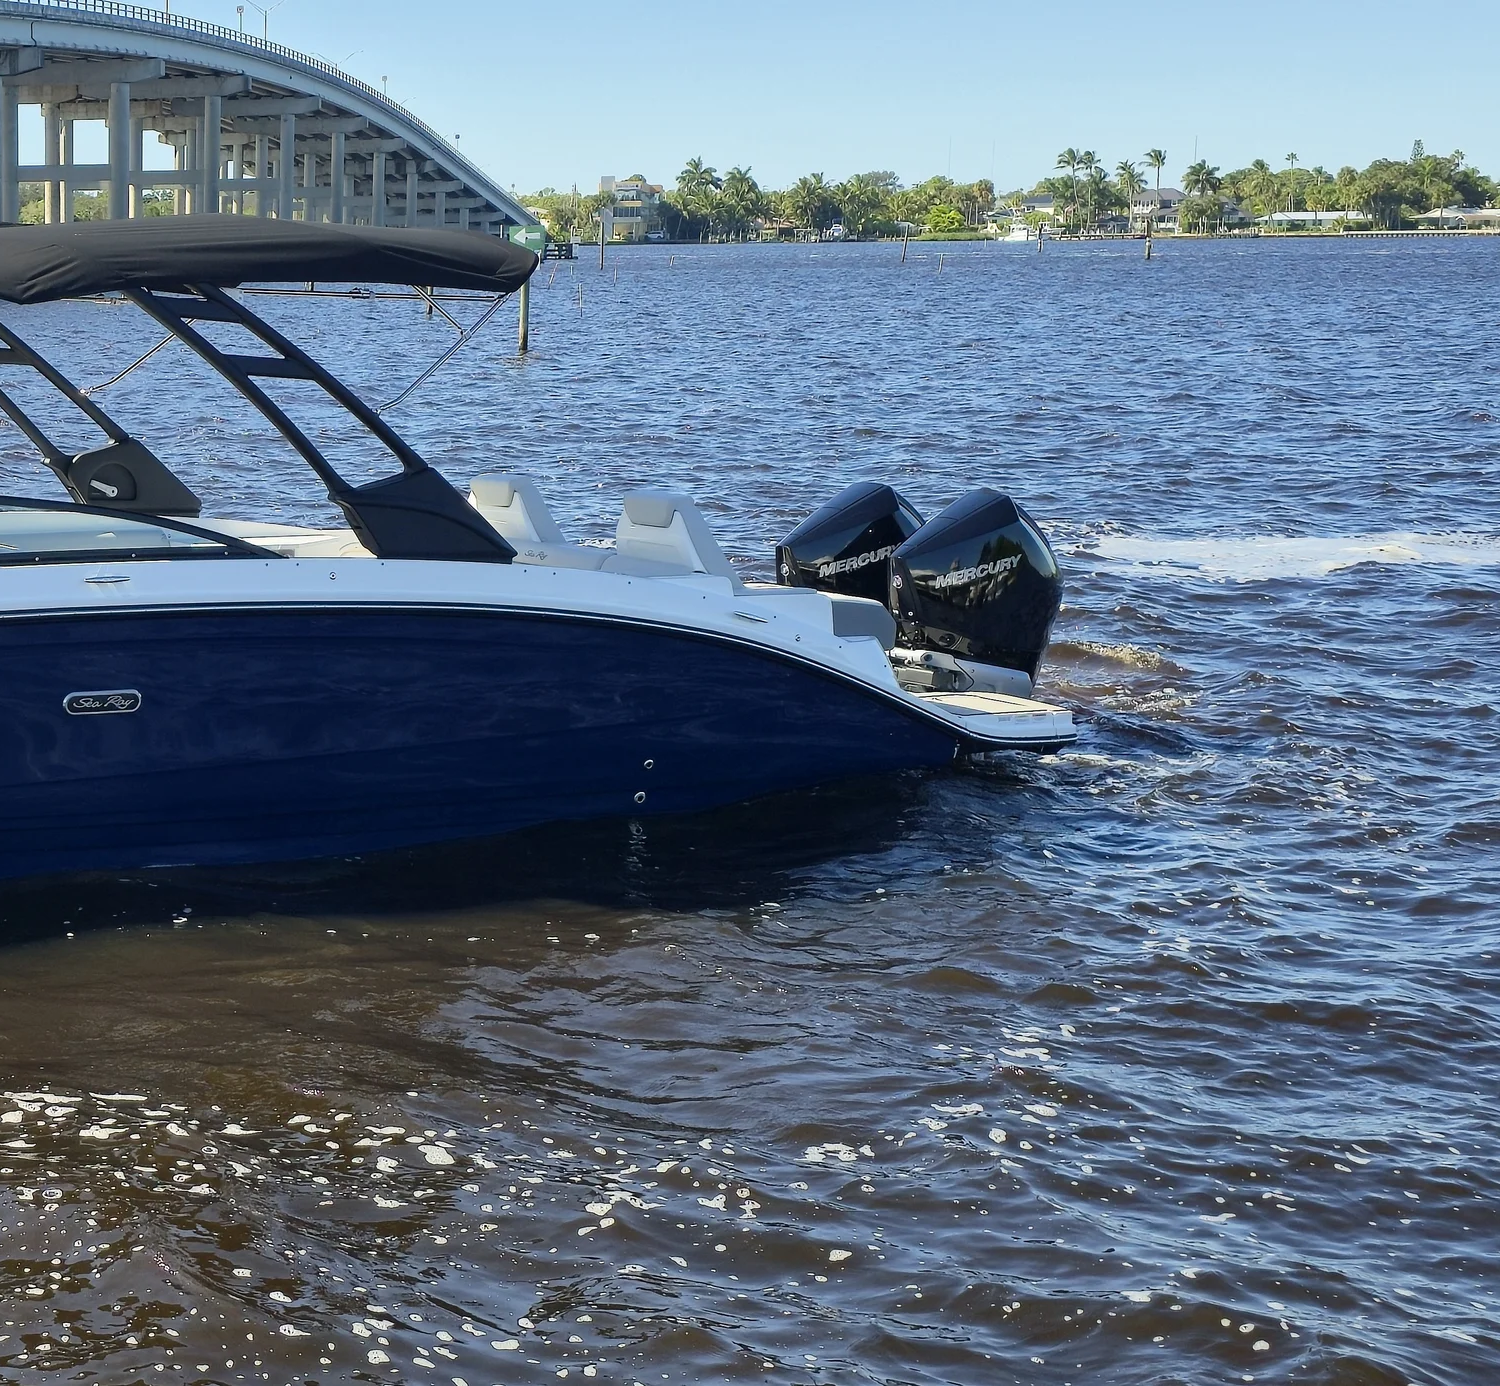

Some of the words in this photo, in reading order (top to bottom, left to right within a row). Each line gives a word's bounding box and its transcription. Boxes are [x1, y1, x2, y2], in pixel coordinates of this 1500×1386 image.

[935, 553, 1023, 589] MERCURY
[72, 697, 103, 708] Sea
[104, 695, 135, 710] Ray
